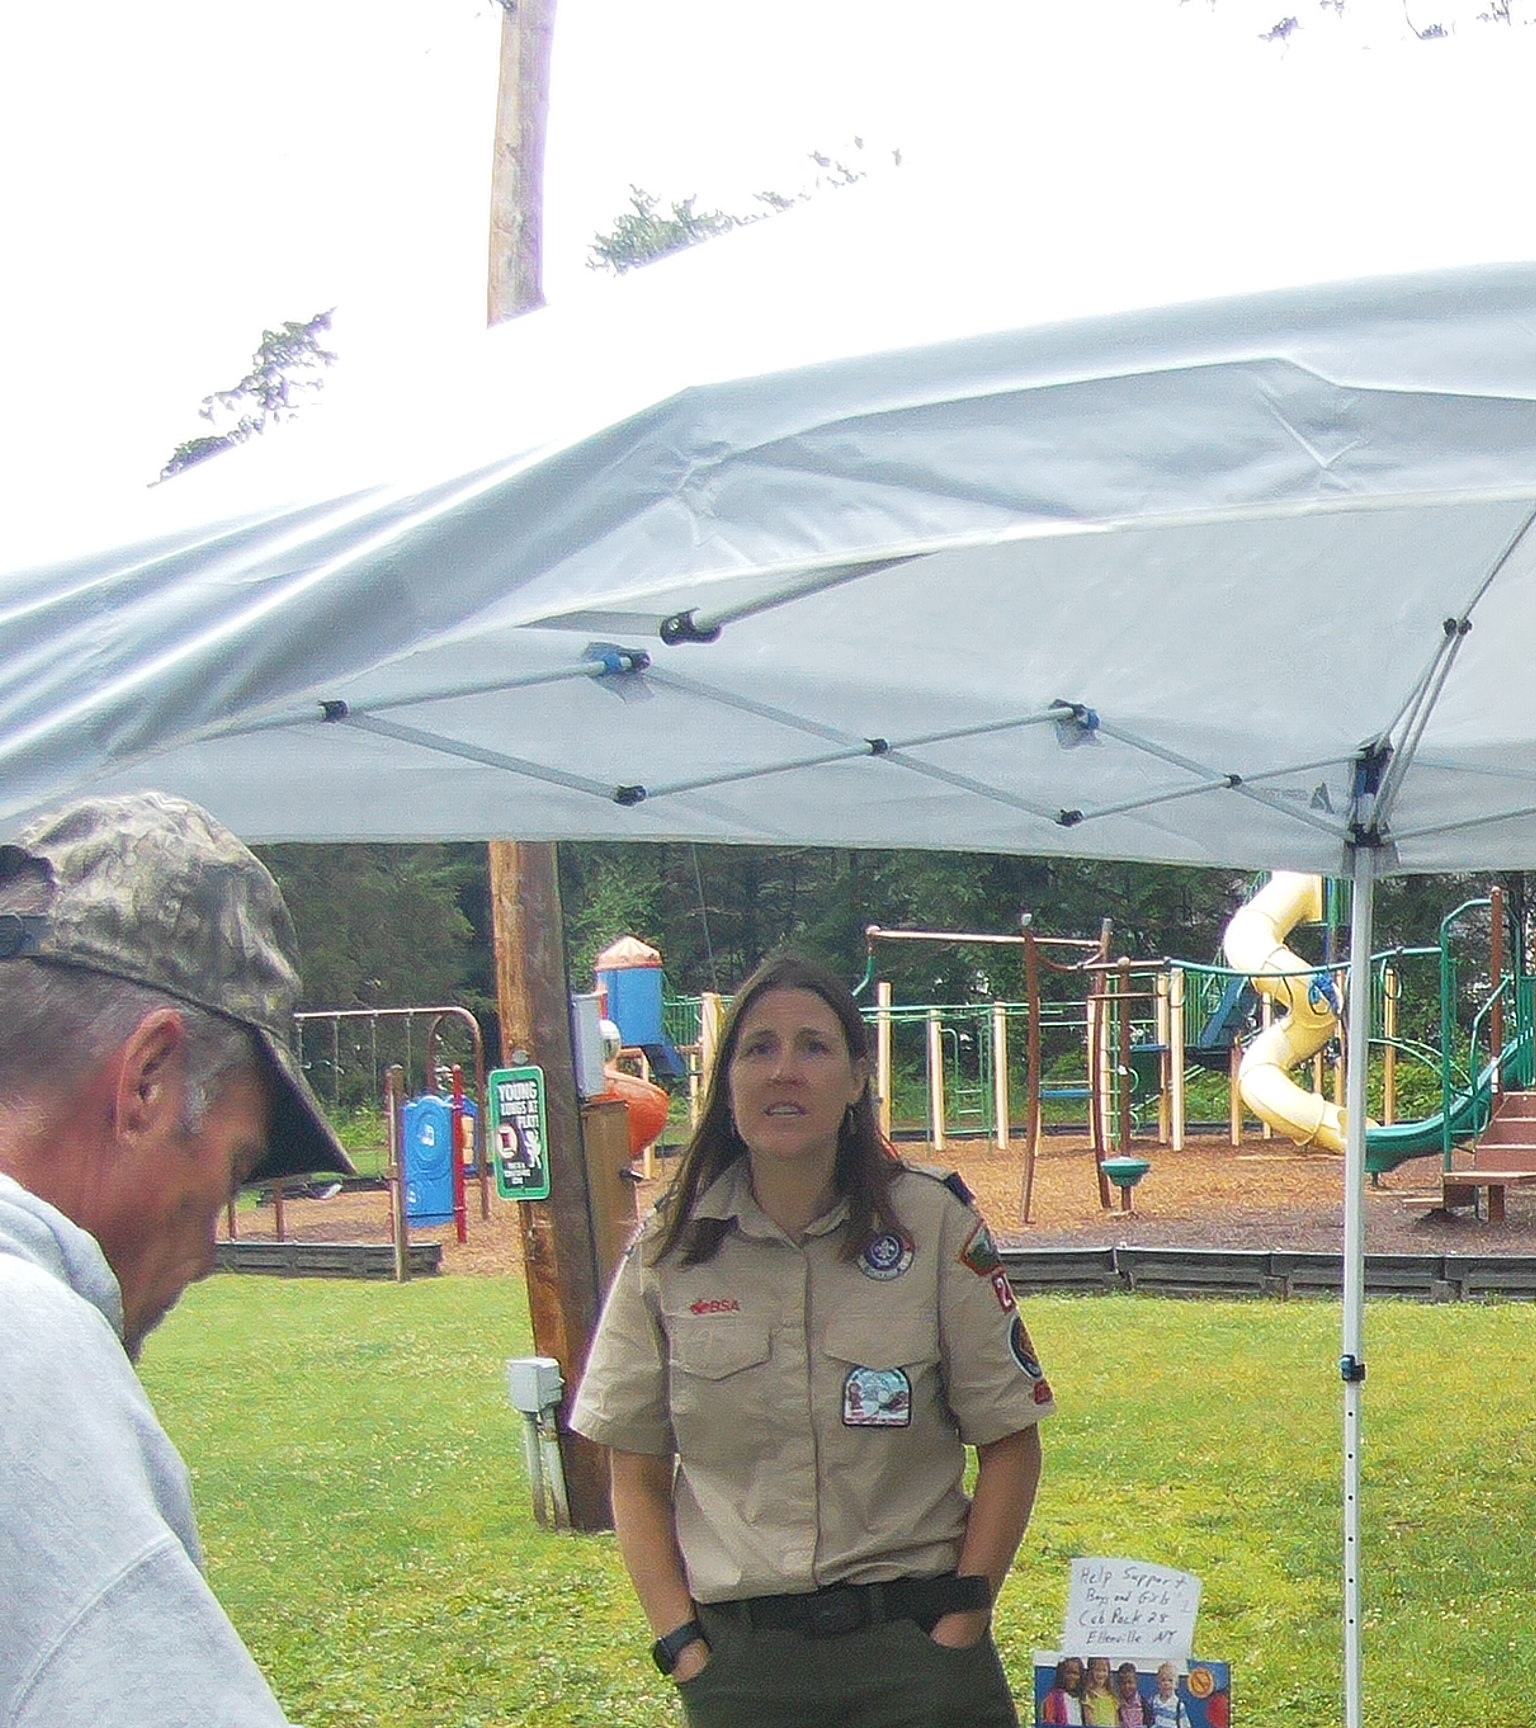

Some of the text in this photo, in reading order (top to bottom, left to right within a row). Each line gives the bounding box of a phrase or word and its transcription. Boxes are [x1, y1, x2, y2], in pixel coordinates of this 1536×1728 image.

[497, 1081, 538, 1102] YOUNG
[710, 1299, 740, 1313] BSA
[1081, 1566, 1188, 1588] Help Support
[1111, 1607, 1143, 1625] Pack
